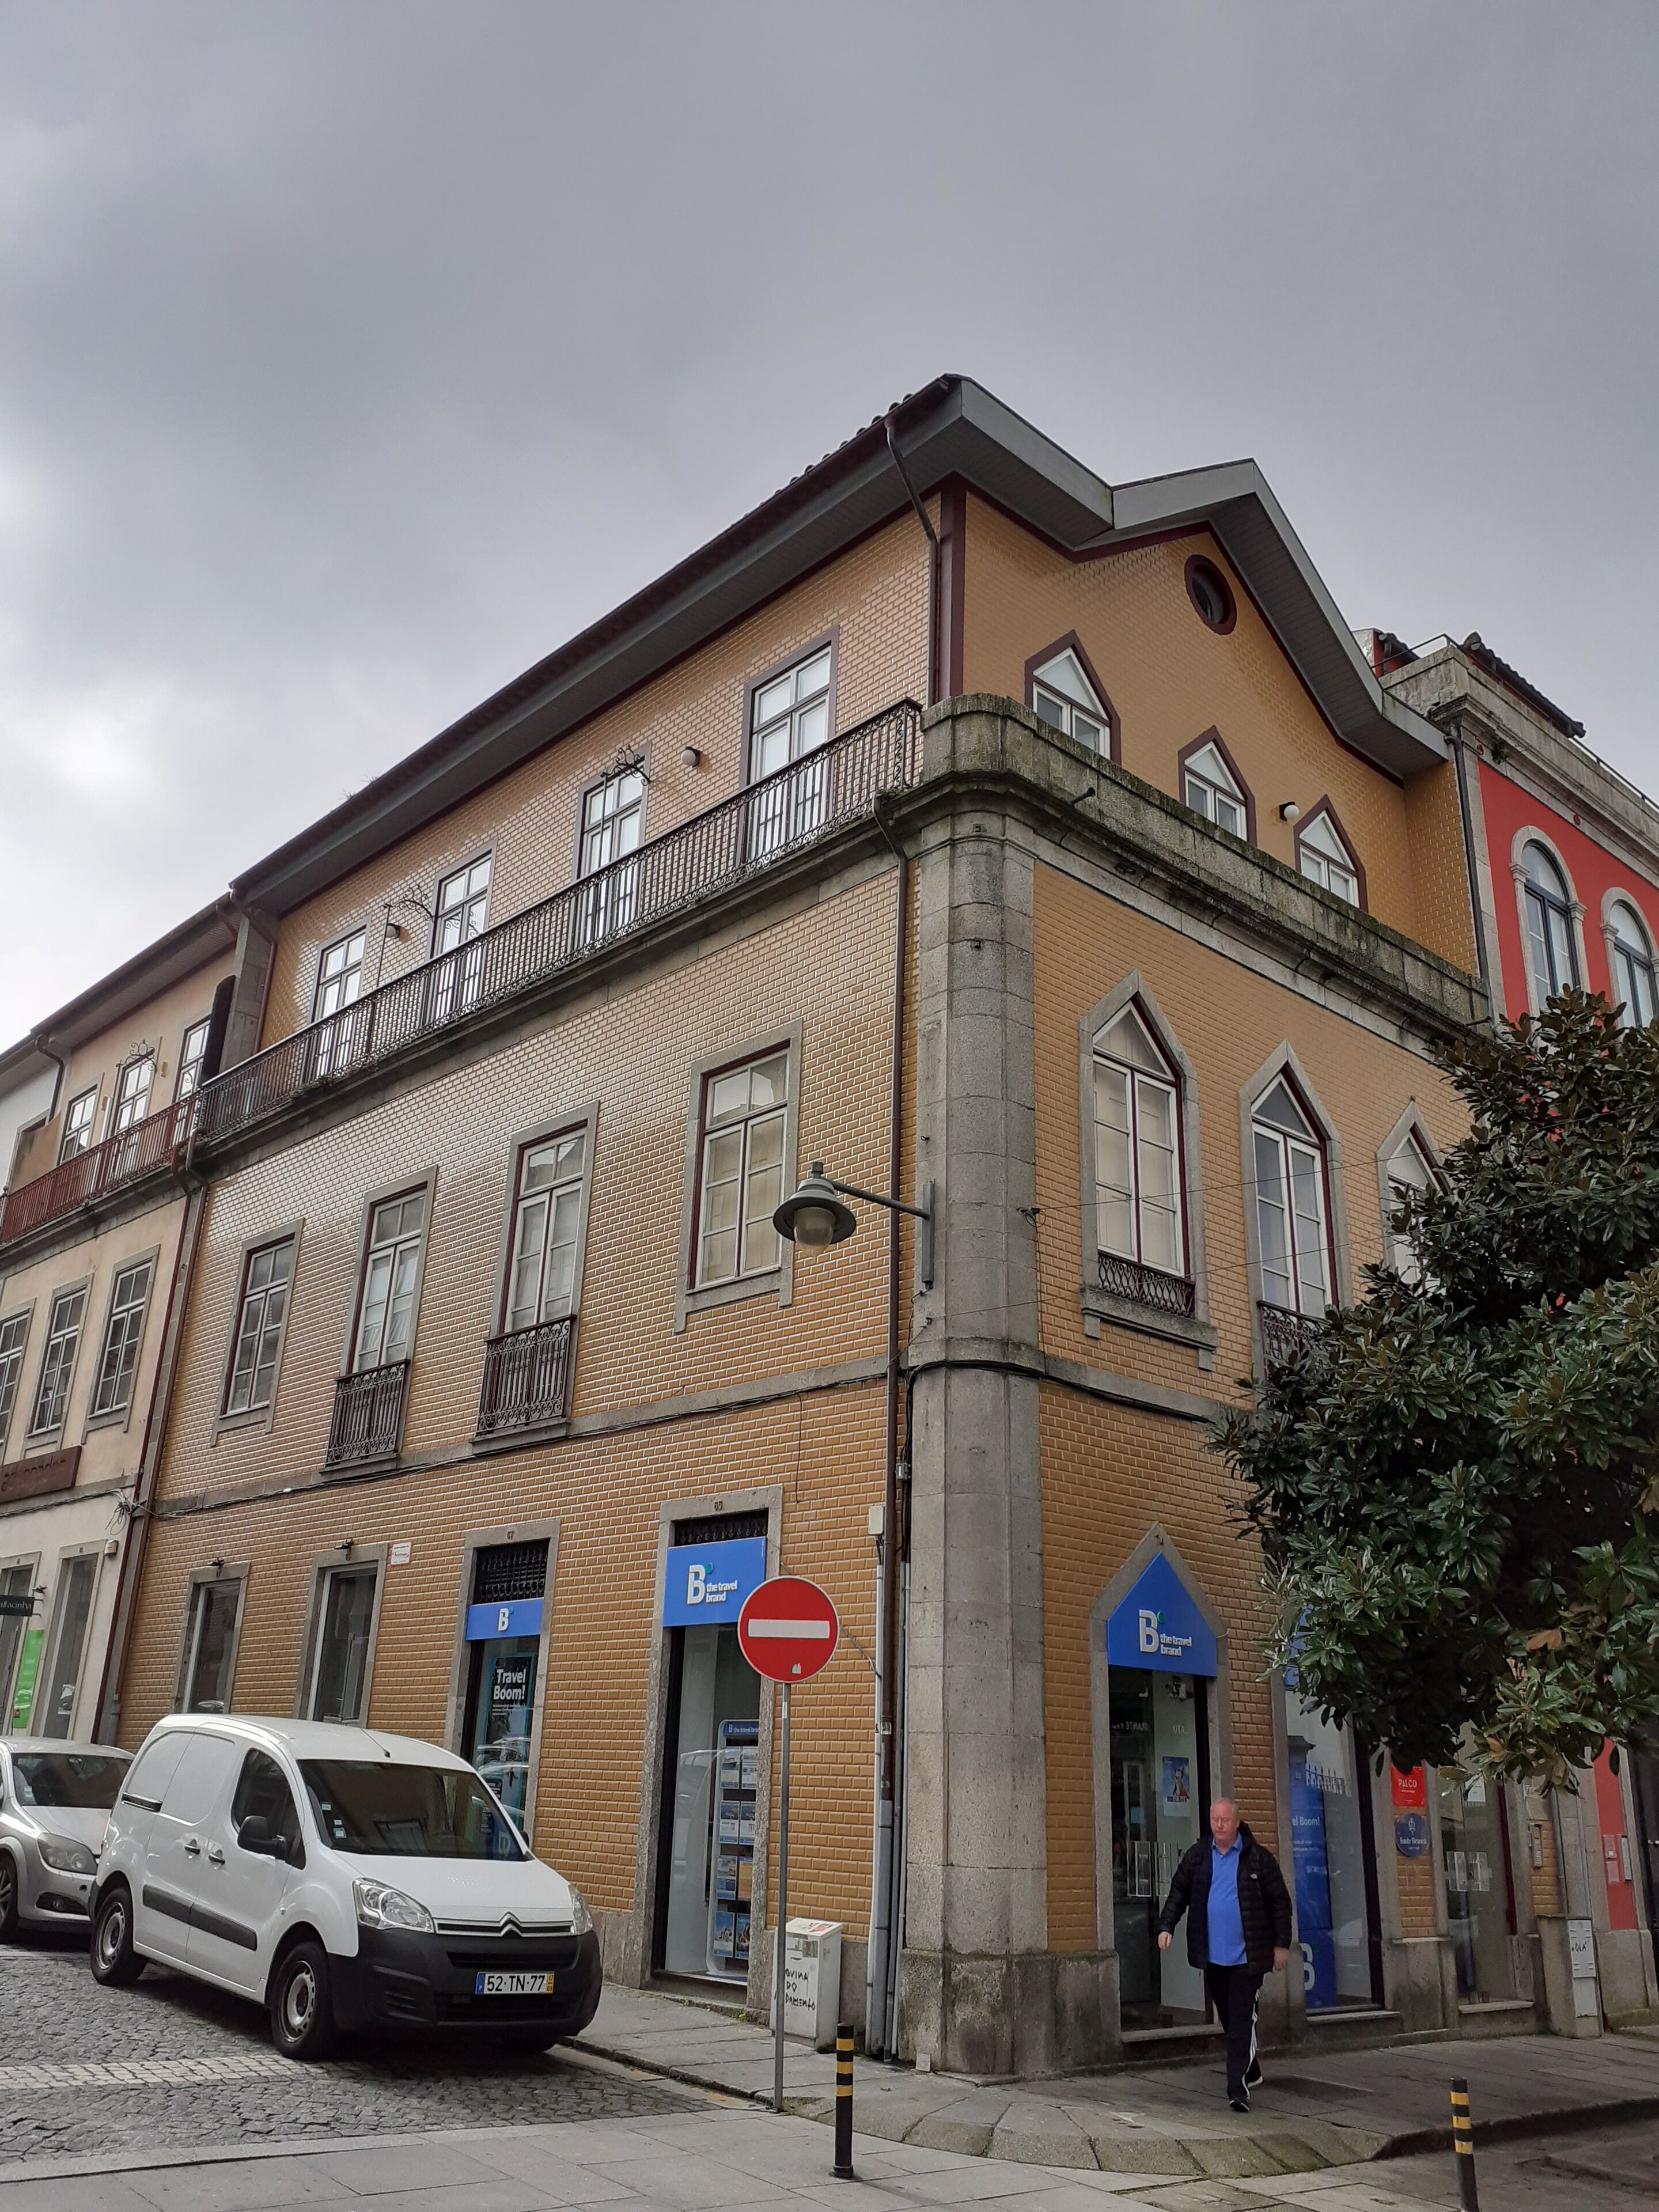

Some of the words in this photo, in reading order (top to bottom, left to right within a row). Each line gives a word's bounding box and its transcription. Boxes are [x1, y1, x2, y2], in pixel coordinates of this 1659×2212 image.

[687, 1565, 706, 1605] B
[706, 1582, 718, 1592] the
[718, 1580, 738, 1591] travel
[706, 1592, 726, 1603] brand
[498, 1608, 510, 1632] B
[1139, 1609, 1159, 1653] B
[1160, 1633, 1172, 1644] the
[1172, 1636, 1192, 1647] travel
[1160, 1644, 1181, 1656] brand
[497, 1668, 527, 1684] Travel
[493, 1685, 526, 1700] Boom!
[1300, 1816, 1320, 1826] Boom!
